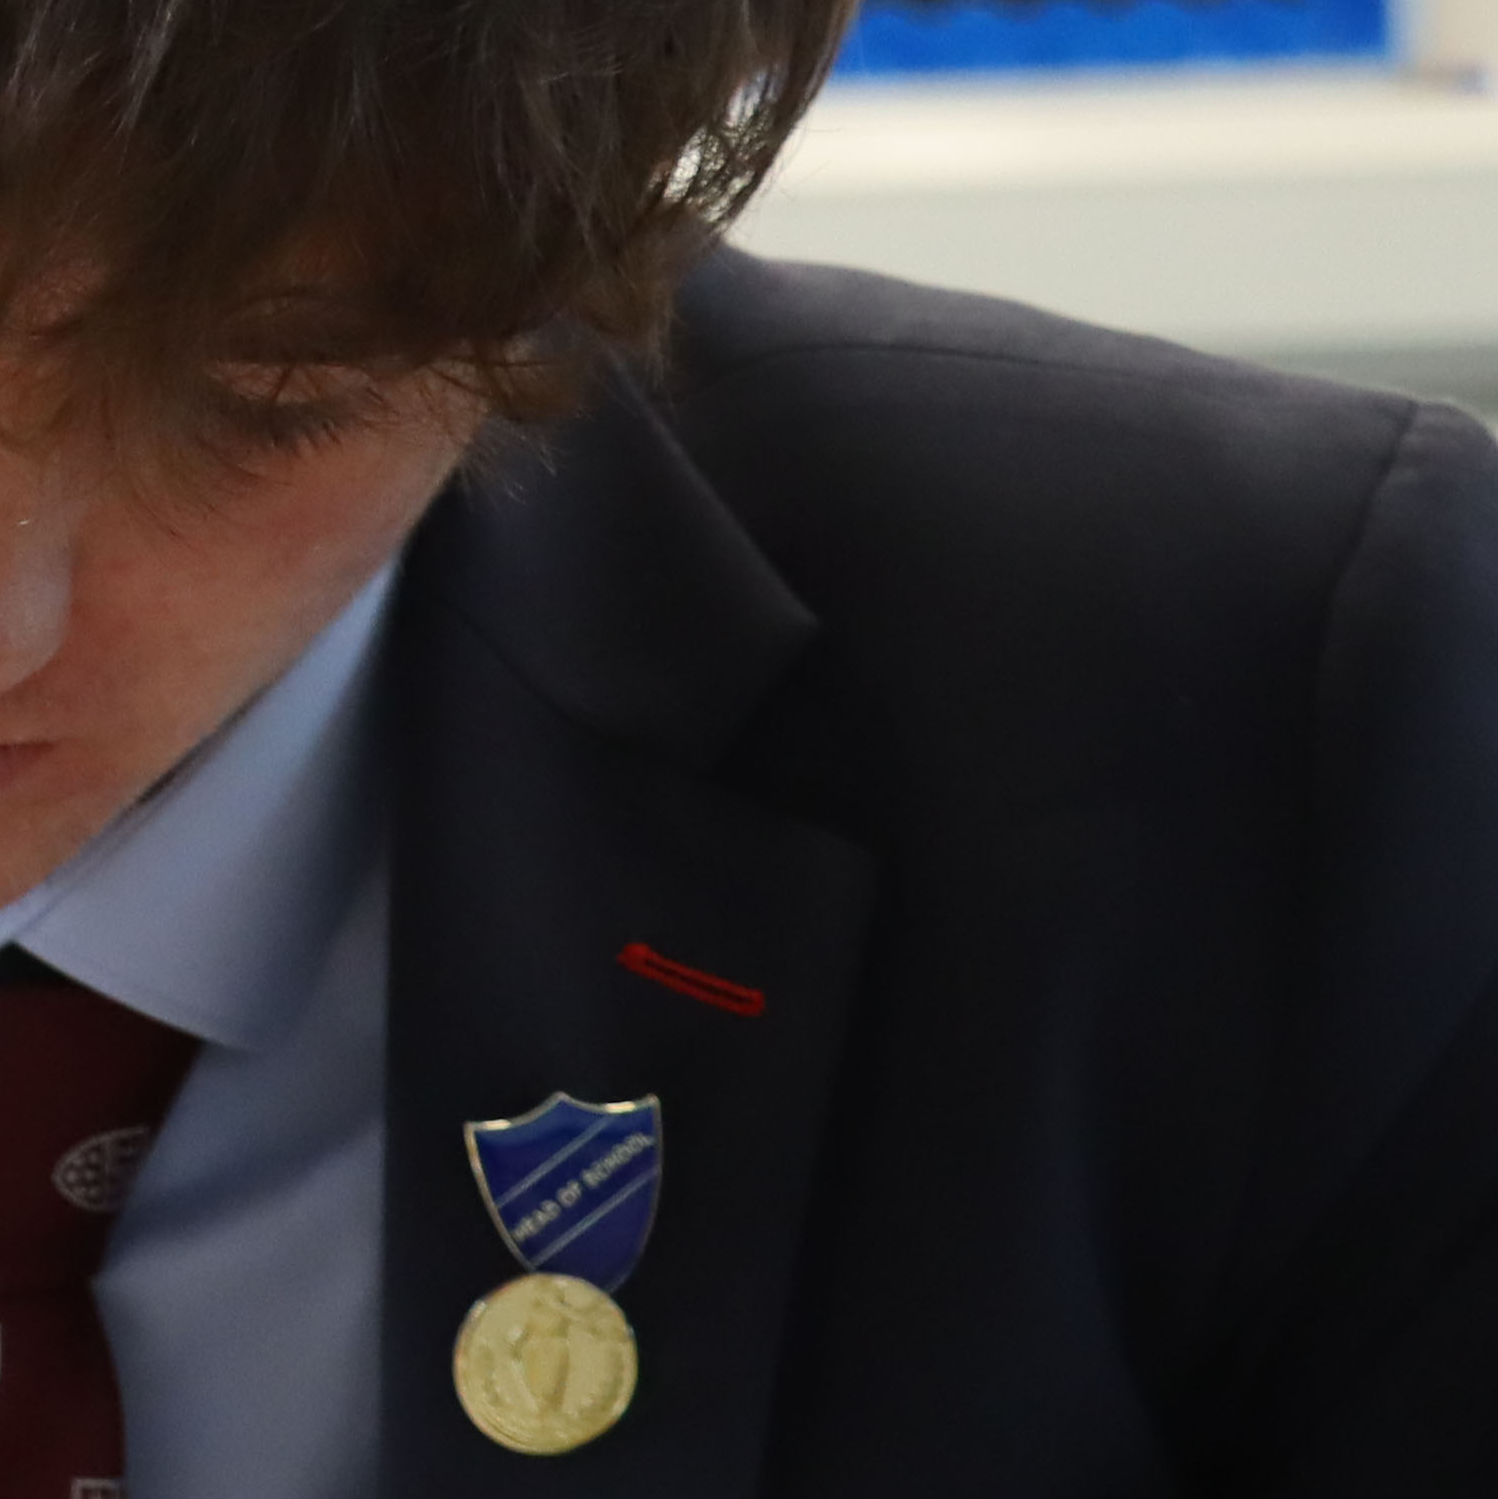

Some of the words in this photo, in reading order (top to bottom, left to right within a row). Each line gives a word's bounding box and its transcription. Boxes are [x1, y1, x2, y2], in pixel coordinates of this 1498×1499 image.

[512, 1199, 560, 1242] HEAD
[556, 1179, 582, 1208] OF
[580, 1132, 654, 1189] SCHOOL
